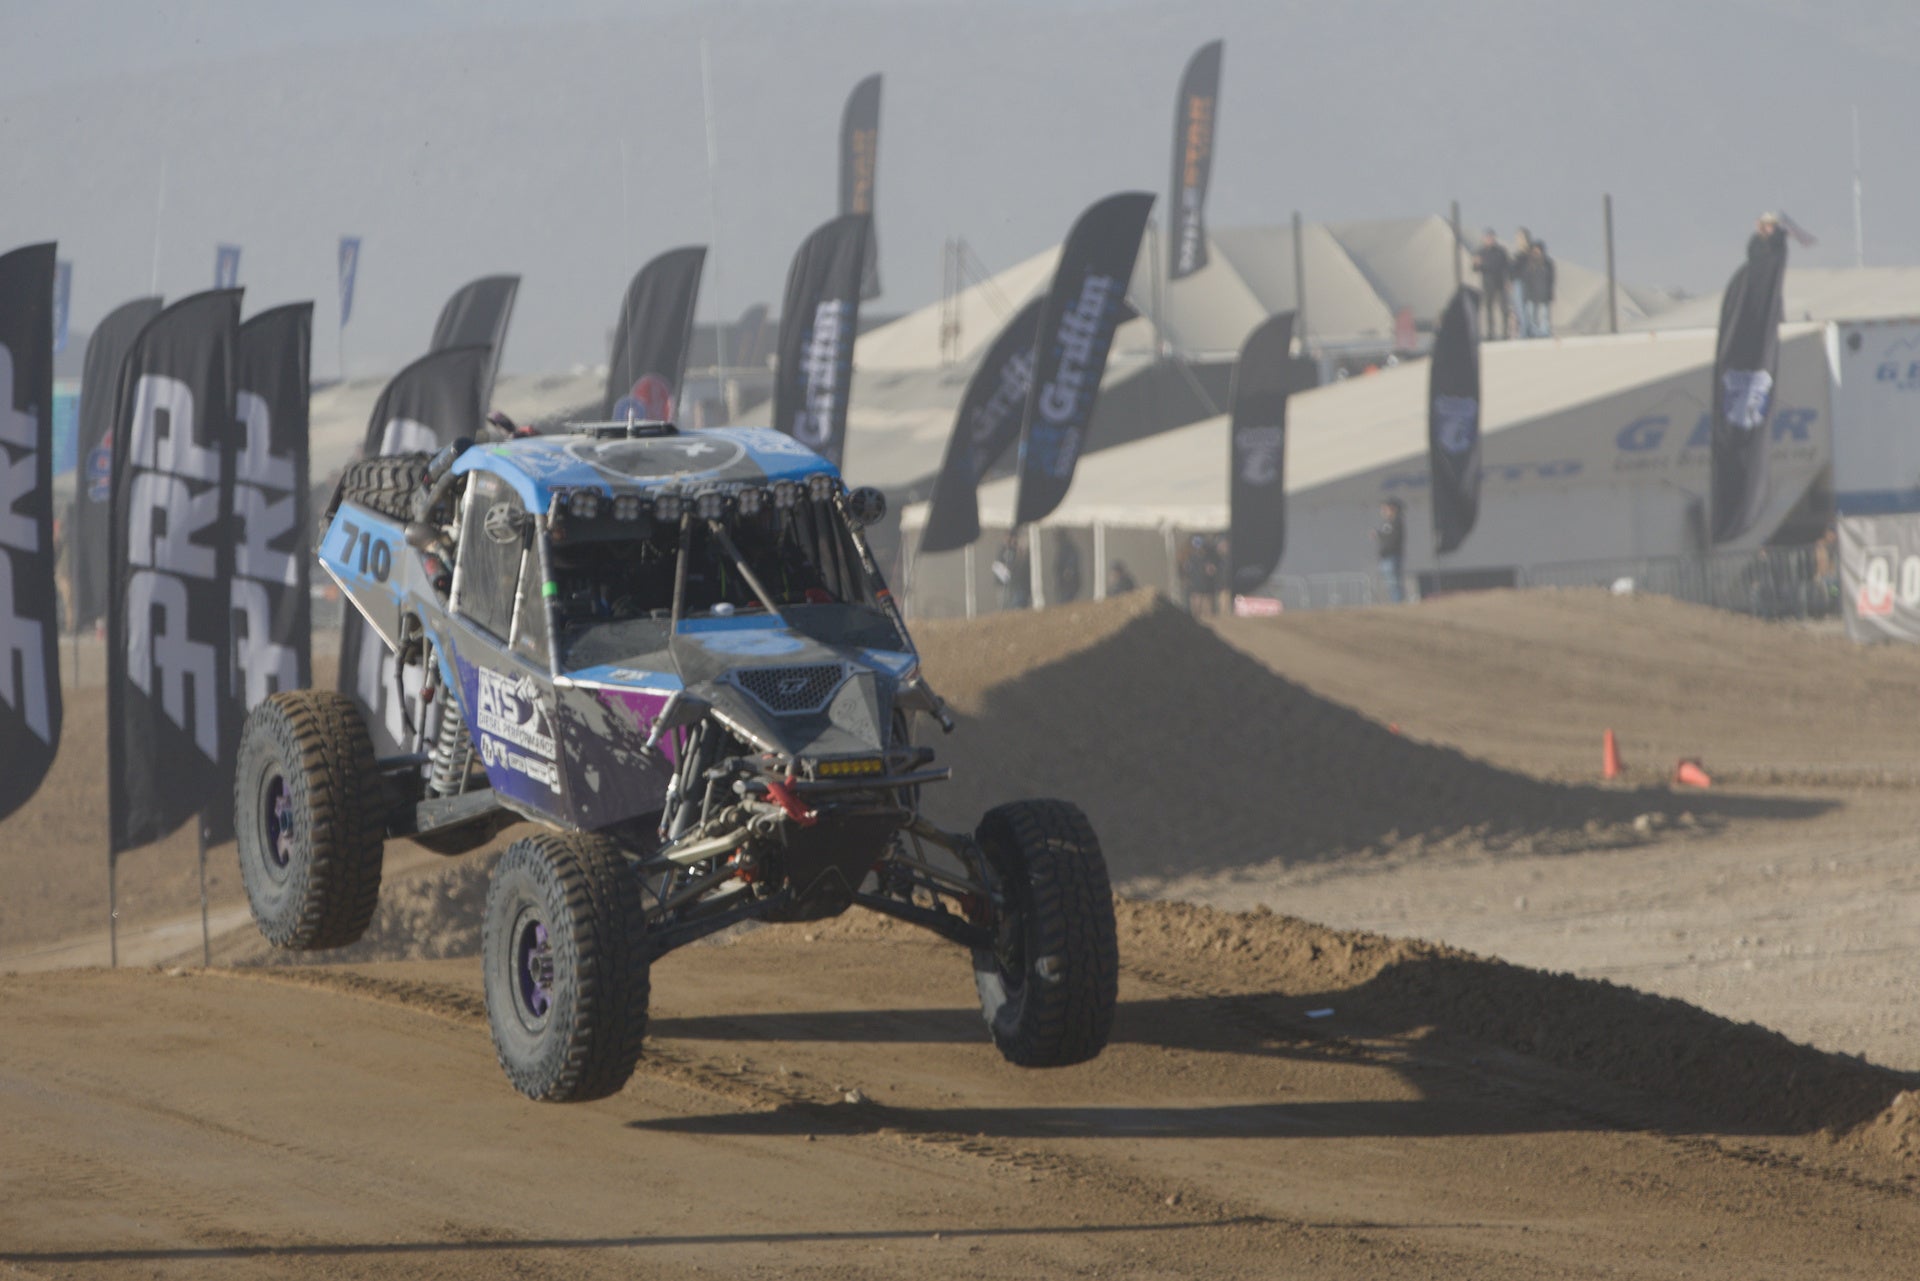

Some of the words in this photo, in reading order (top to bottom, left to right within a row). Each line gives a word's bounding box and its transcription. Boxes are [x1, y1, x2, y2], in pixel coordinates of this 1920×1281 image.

[1038, 273, 1114, 423] Griffin
[128, 373, 222, 764] PRP
[341, 520, 391, 583] 710
[478, 674, 519, 725] ATS
[479, 712, 501, 734] DIESEL
